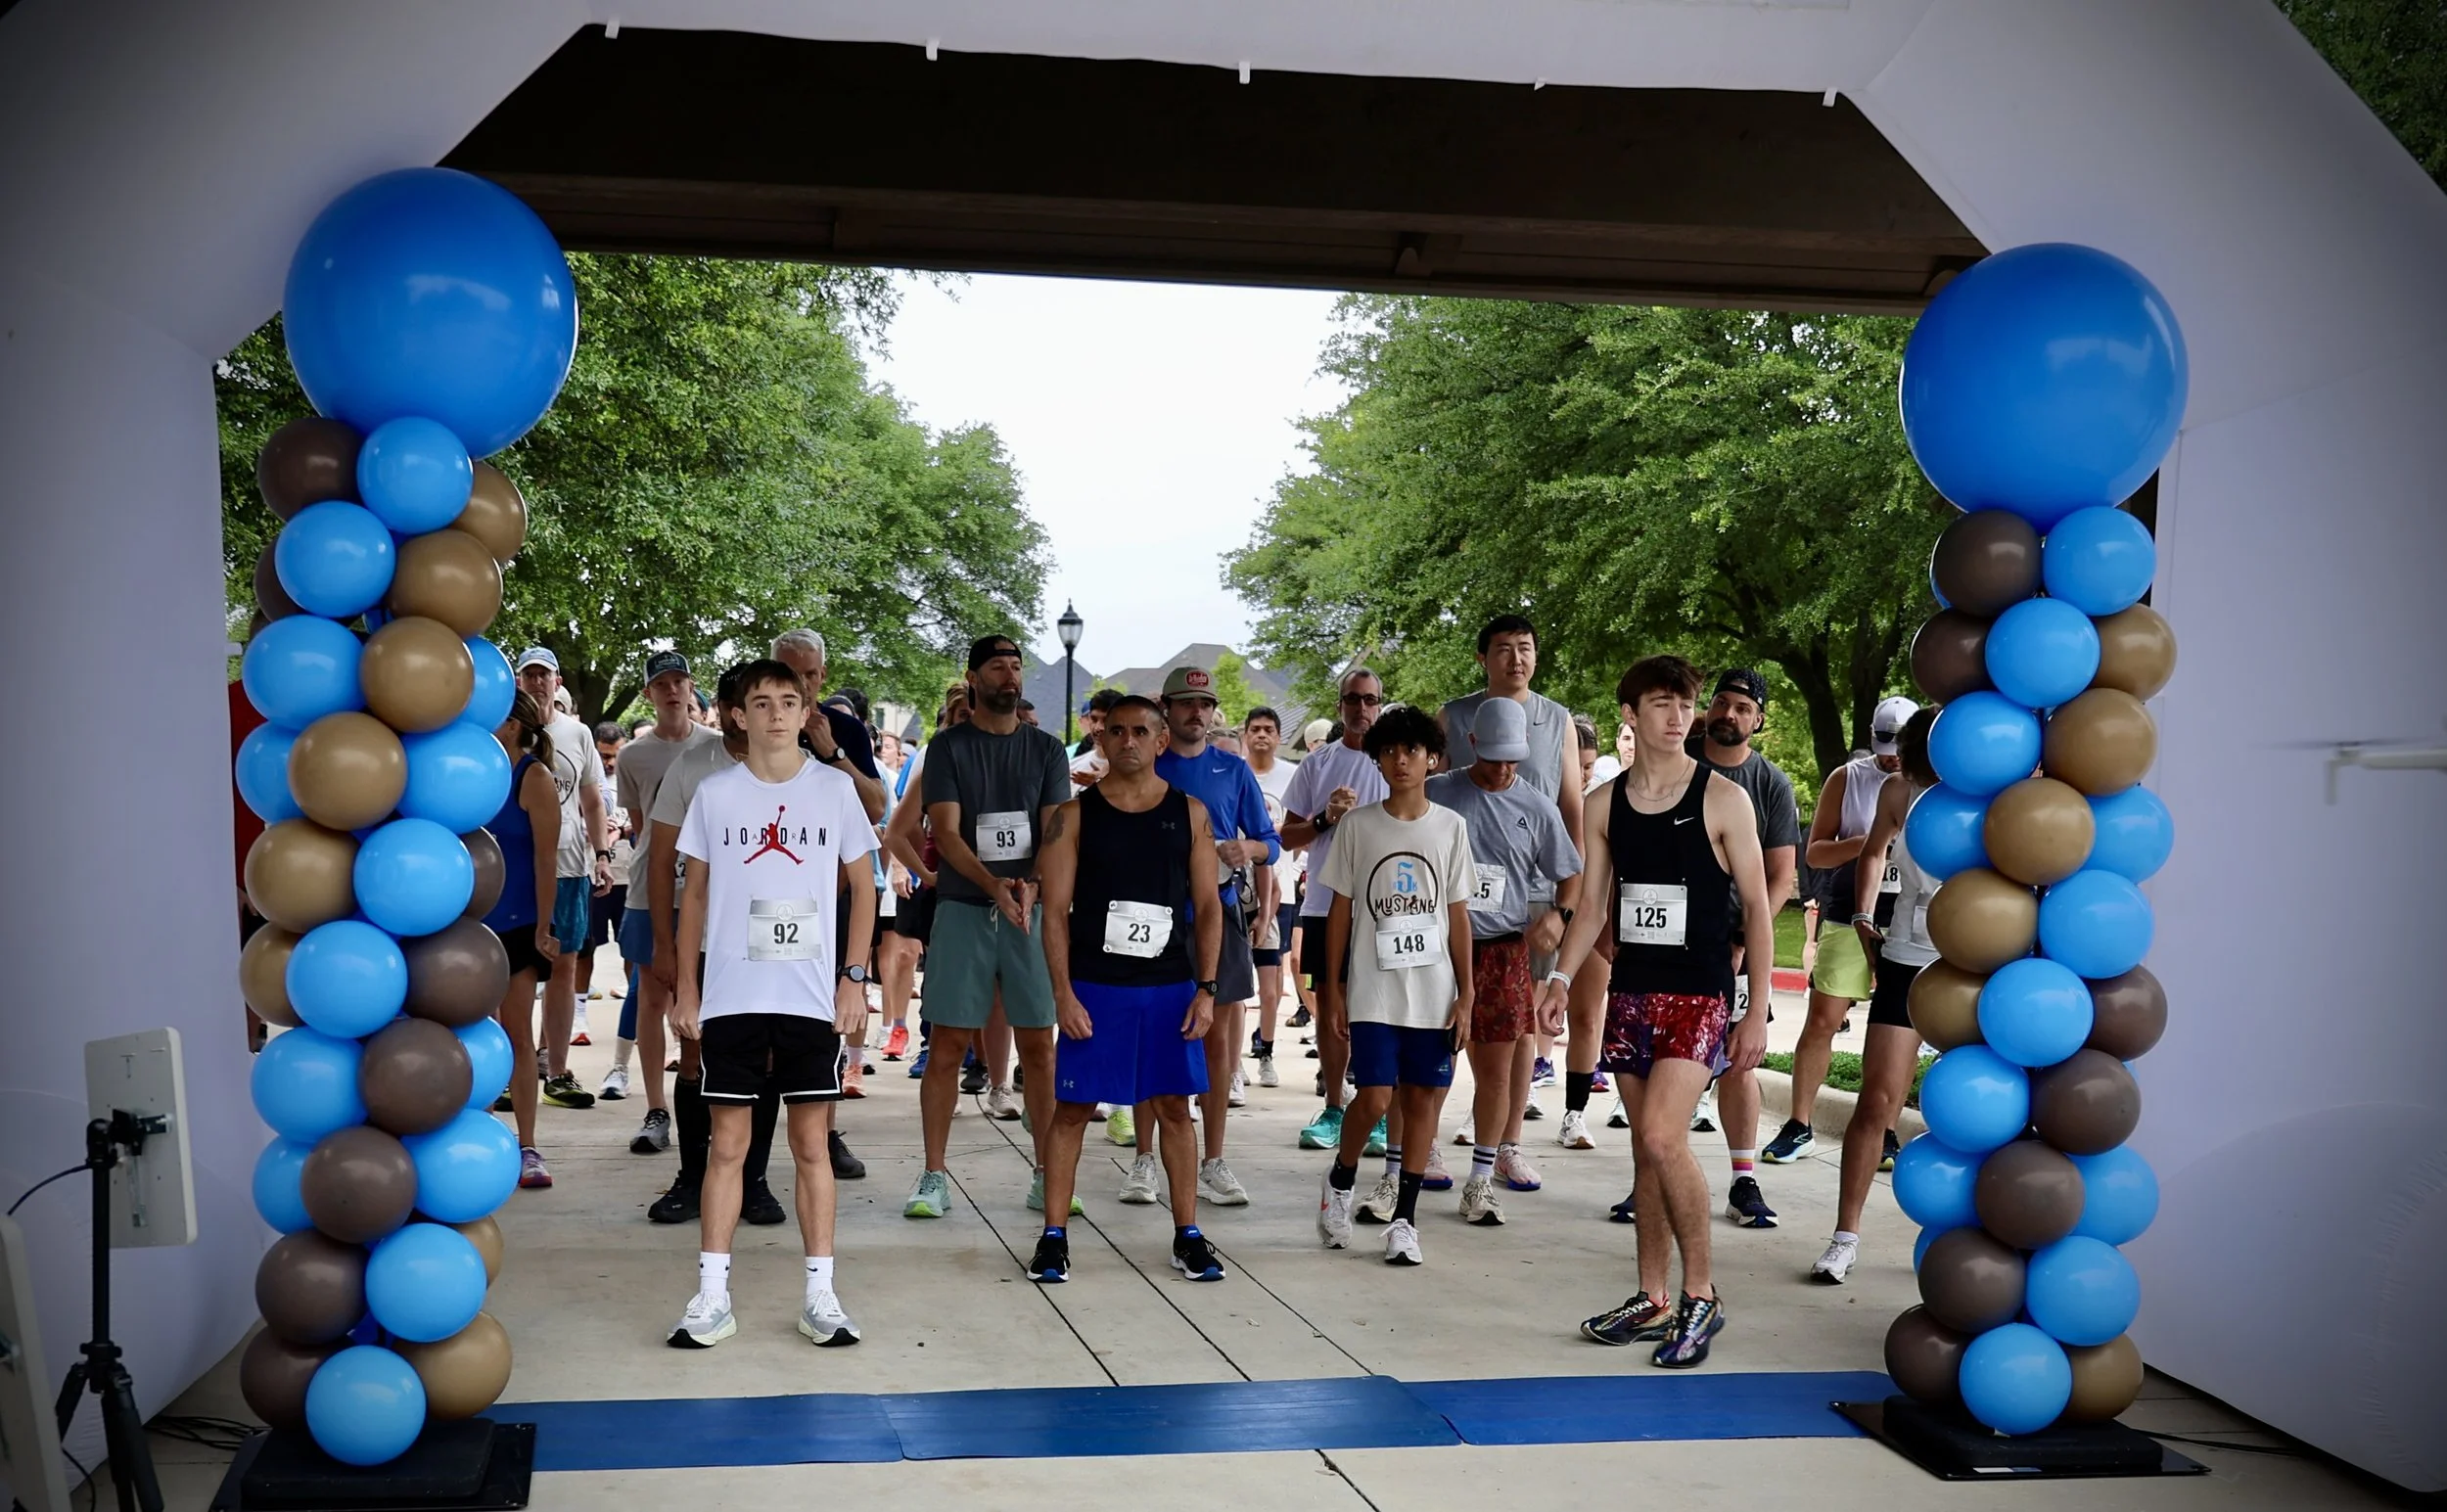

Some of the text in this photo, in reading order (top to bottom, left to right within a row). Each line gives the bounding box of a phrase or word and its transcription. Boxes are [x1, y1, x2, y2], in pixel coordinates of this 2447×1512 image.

[723, 827, 827, 847] JORDAN
[996, 831, 1016, 848] 93
[1374, 894, 1436, 916] MUSTANG
[1635, 906, 1667, 929] 125
[773, 923, 799, 944] 92
[1128, 923, 1151, 943] 23
[1393, 934, 1425, 954] 148
